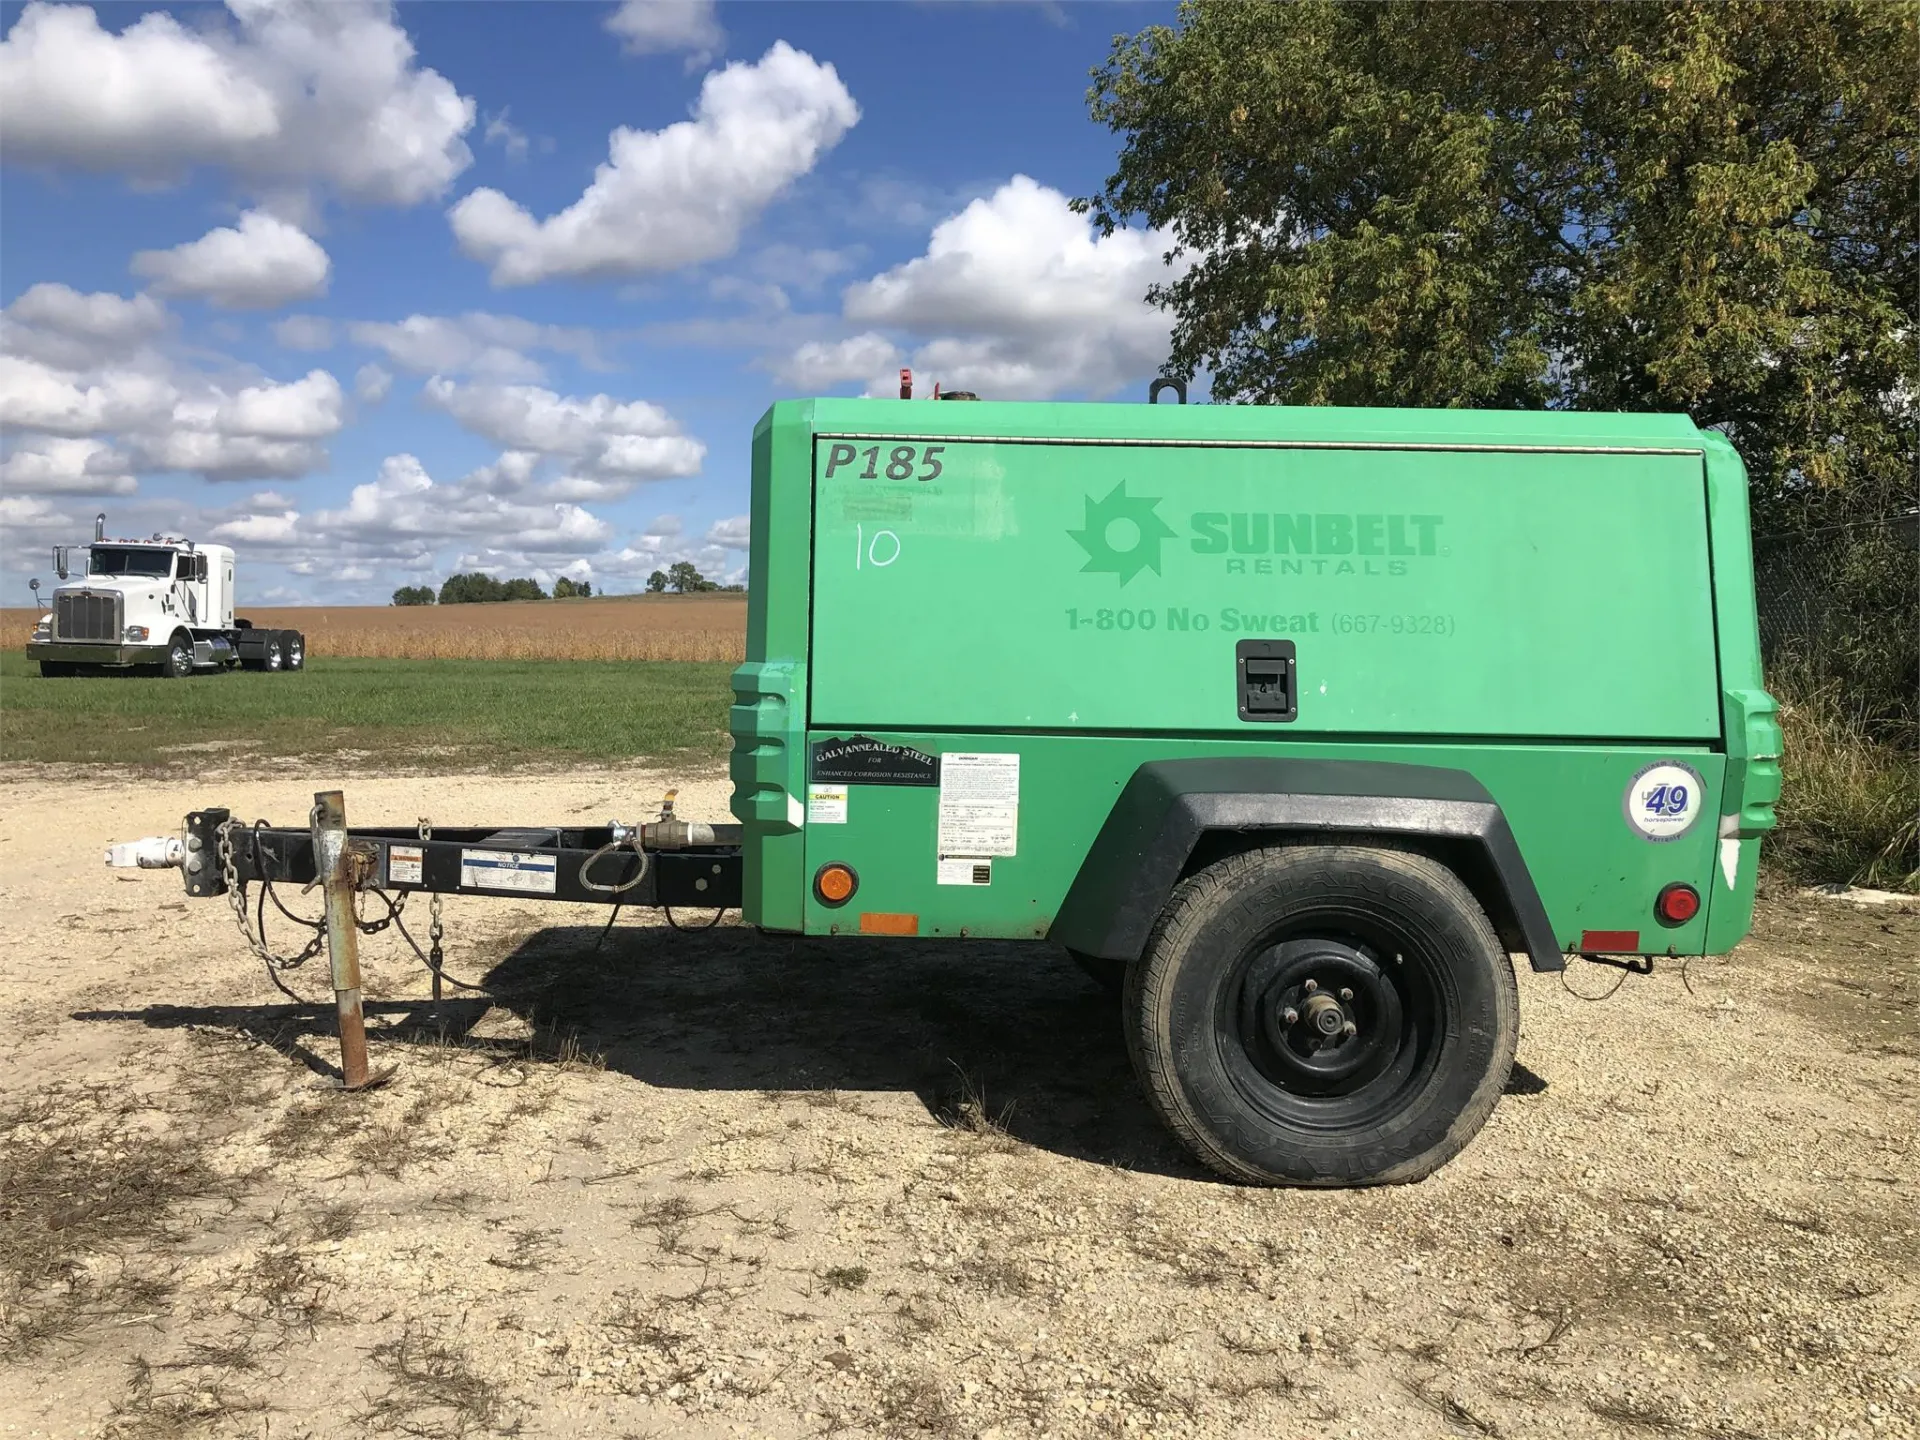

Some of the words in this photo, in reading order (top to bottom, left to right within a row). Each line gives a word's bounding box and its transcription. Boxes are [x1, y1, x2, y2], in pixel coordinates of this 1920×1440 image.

[824, 443, 946, 482] P185
[855, 522, 901, 571] 10
[1190, 512, 1444, 557] SUNBELT
[1226, 558, 1409, 577] RENTALS
[1065, 607, 1157, 632] 1-800
[1166, 606, 1210, 632] No
[1219, 607, 1320, 634] Sweat
[1331, 611, 1456, 637] (667-9328)
[816, 743, 900, 763] GALVANNEALED
[902, 748, 933, 766] STEEL
[853, 770, 893, 778] CORROSION
[893, 771, 931, 779] RESISTANCE
[1645, 785, 1688, 814] 49
